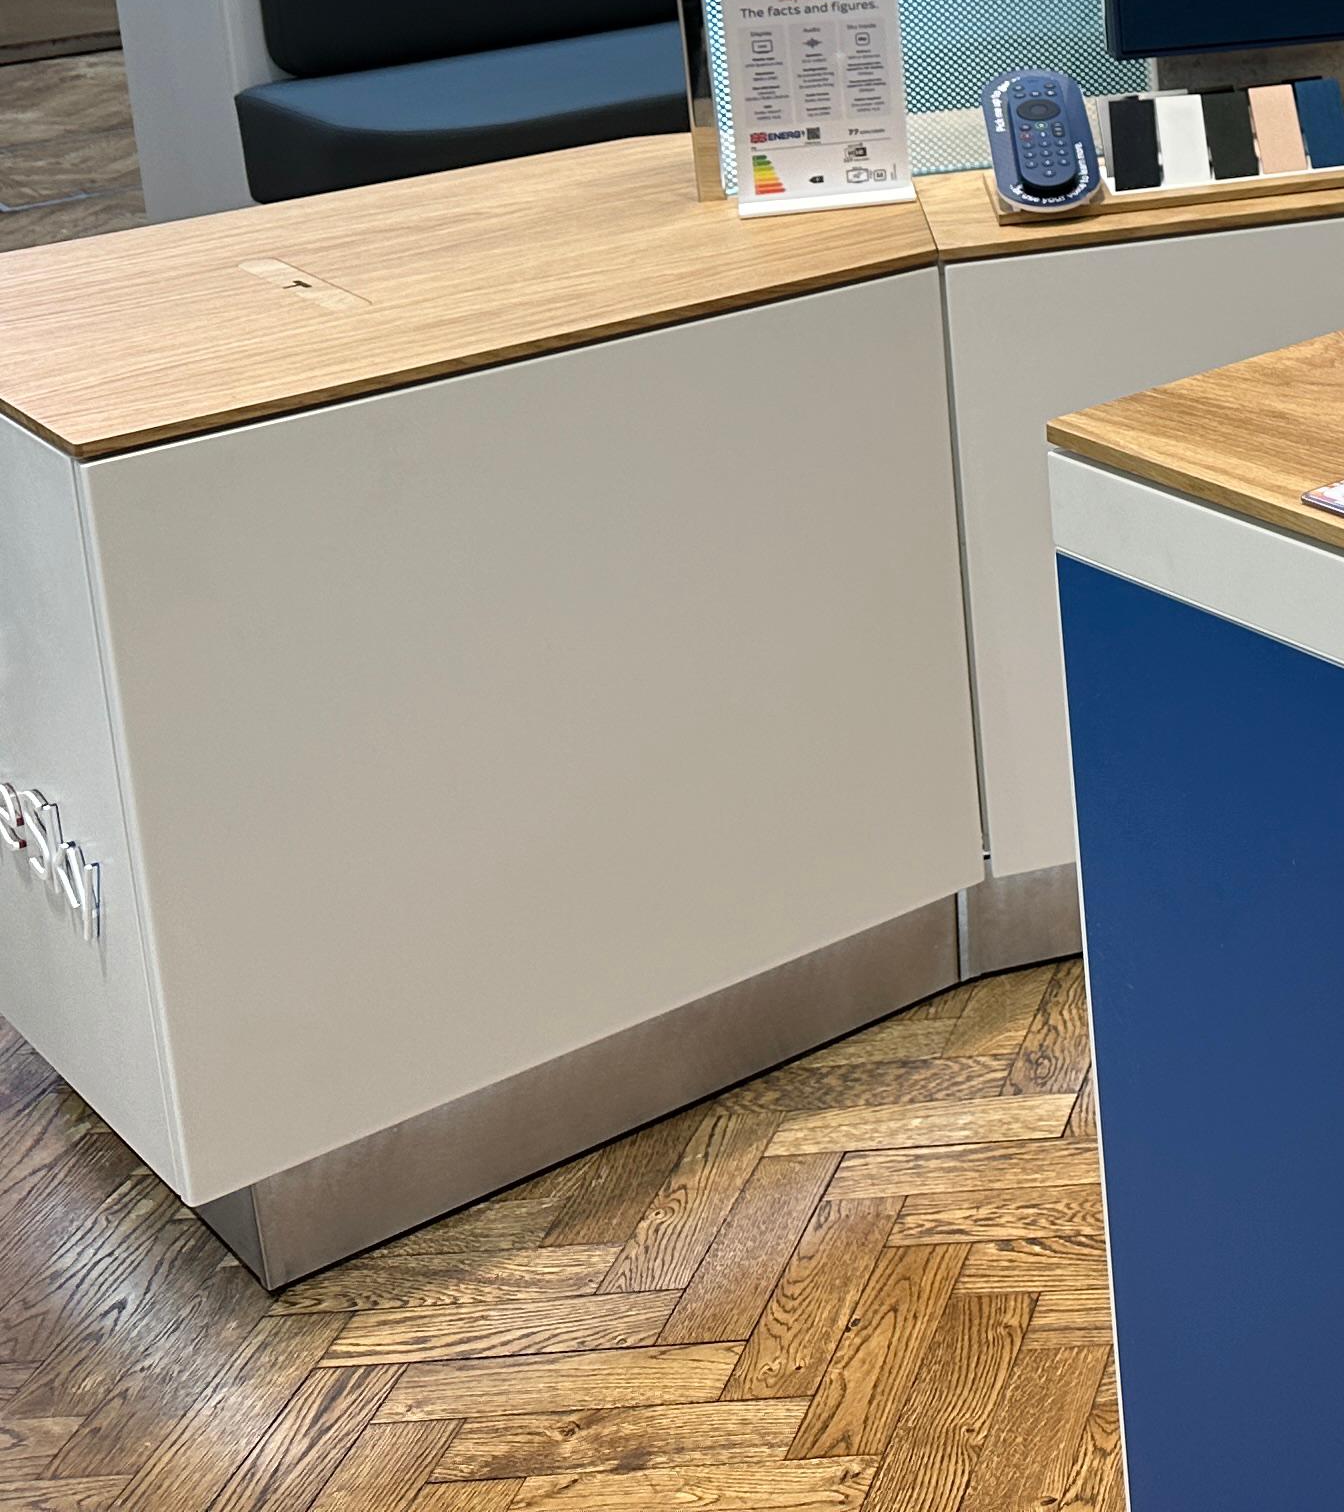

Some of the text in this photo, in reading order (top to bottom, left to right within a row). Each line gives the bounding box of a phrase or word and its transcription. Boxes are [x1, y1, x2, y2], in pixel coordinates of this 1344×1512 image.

[740, 0, 879, 19] The facts and figures.
